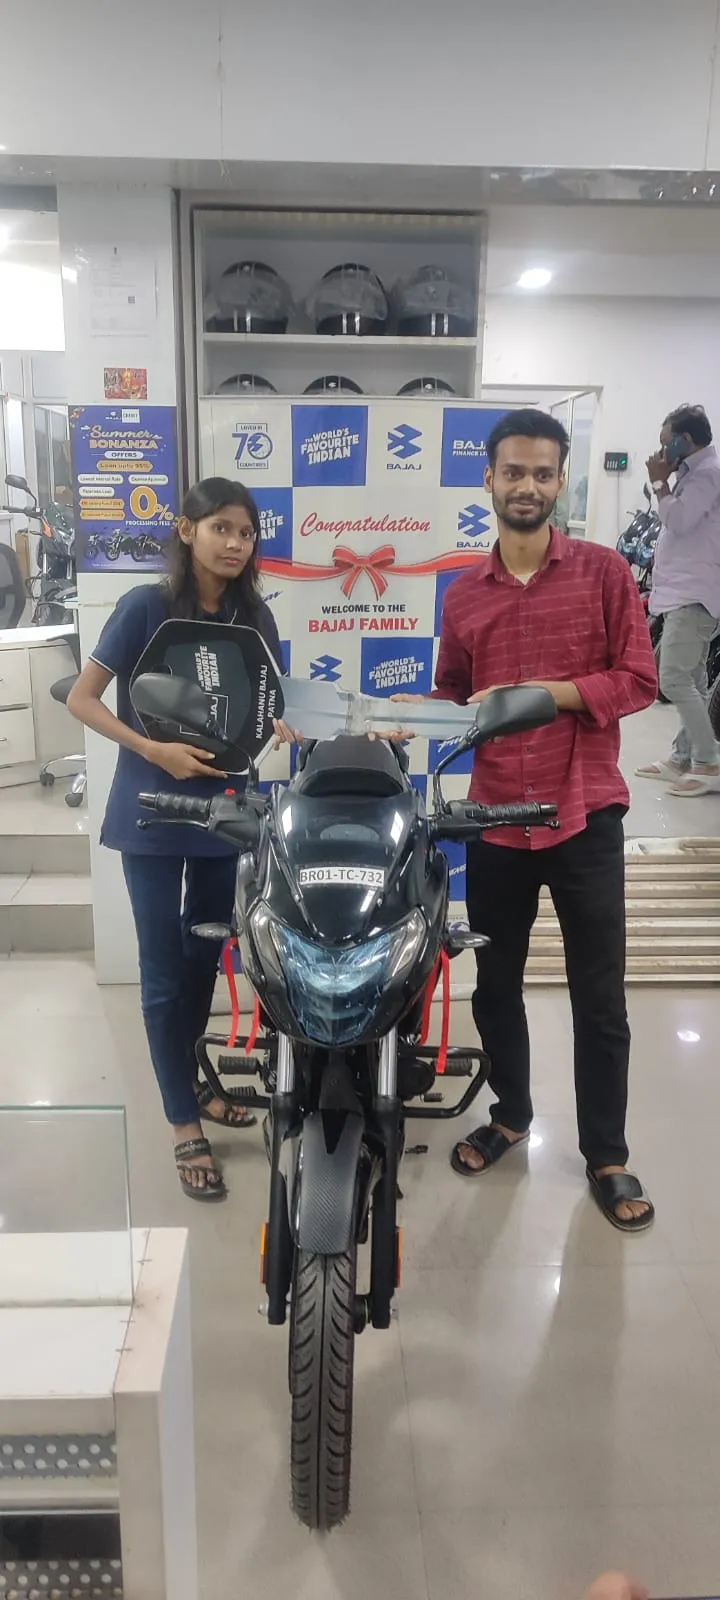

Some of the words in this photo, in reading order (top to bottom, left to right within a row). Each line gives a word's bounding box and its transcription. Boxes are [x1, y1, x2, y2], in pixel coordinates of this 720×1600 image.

[90, 424, 153, 438] Summer
[312, 427, 350, 442] WORLD'S
[89, 439, 159, 449] BONANZA
[300, 433, 360, 455] FAVOURITE
[453, 440, 487, 450] BAJ
[308, 446, 351, 465] INDIAN
[300, 512, 430, 539] Congratulation
[321, 604, 371, 614] WELCOME
[372, 604, 386, 613] TO
[387, 604, 406, 612] THE
[308, 618, 355, 633] BAJAJ
[359, 617, 420, 631] FAMILY
[200, 645, 213, 692] FAVOURITE
[207, 652, 220, 688] INDIAN
[368, 661, 425, 681] FAVOURITE
[380, 656, 415, 670] WORLD'S
[259, 664, 268, 691] BAJAJ
[375, 672, 417, 689] INDIAN
[267, 689, 277, 718] PATNA
[255, 692, 266, 739] KALAHANU
[300, 869, 383, 884] BR01-TC-732
